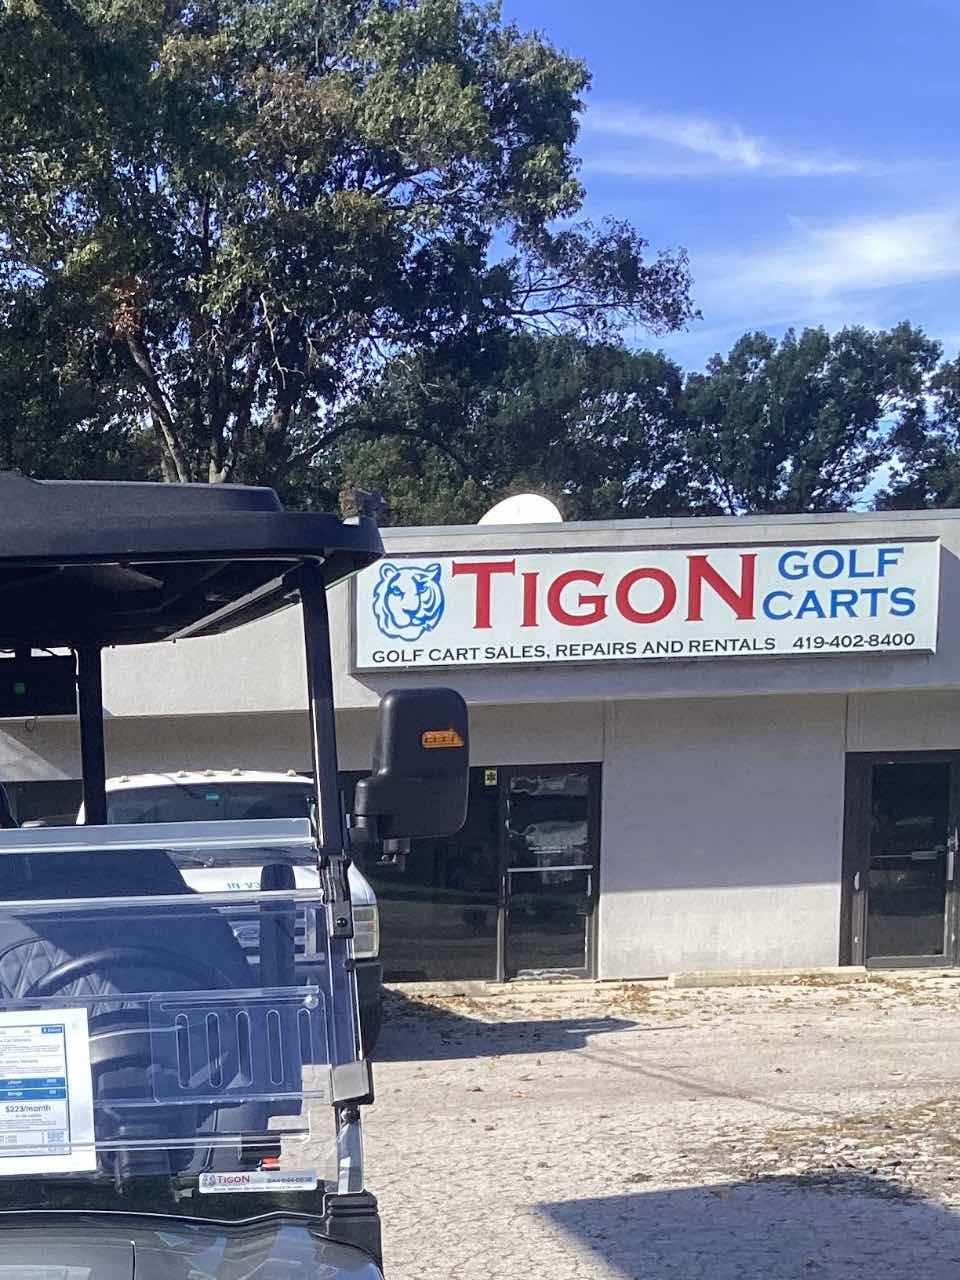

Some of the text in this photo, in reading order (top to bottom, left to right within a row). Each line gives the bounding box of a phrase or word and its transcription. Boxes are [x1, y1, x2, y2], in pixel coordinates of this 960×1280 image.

[778, 546, 904, 580] GOLF
[451, 553, 758, 629] TIGON
[762, 587, 916, 620] CARTS
[372, 633, 916, 663] GOLF CART SALES, REPAIRS AND RENTALS 419-402-8400
[218, 1175, 250, 1184] TIGON
